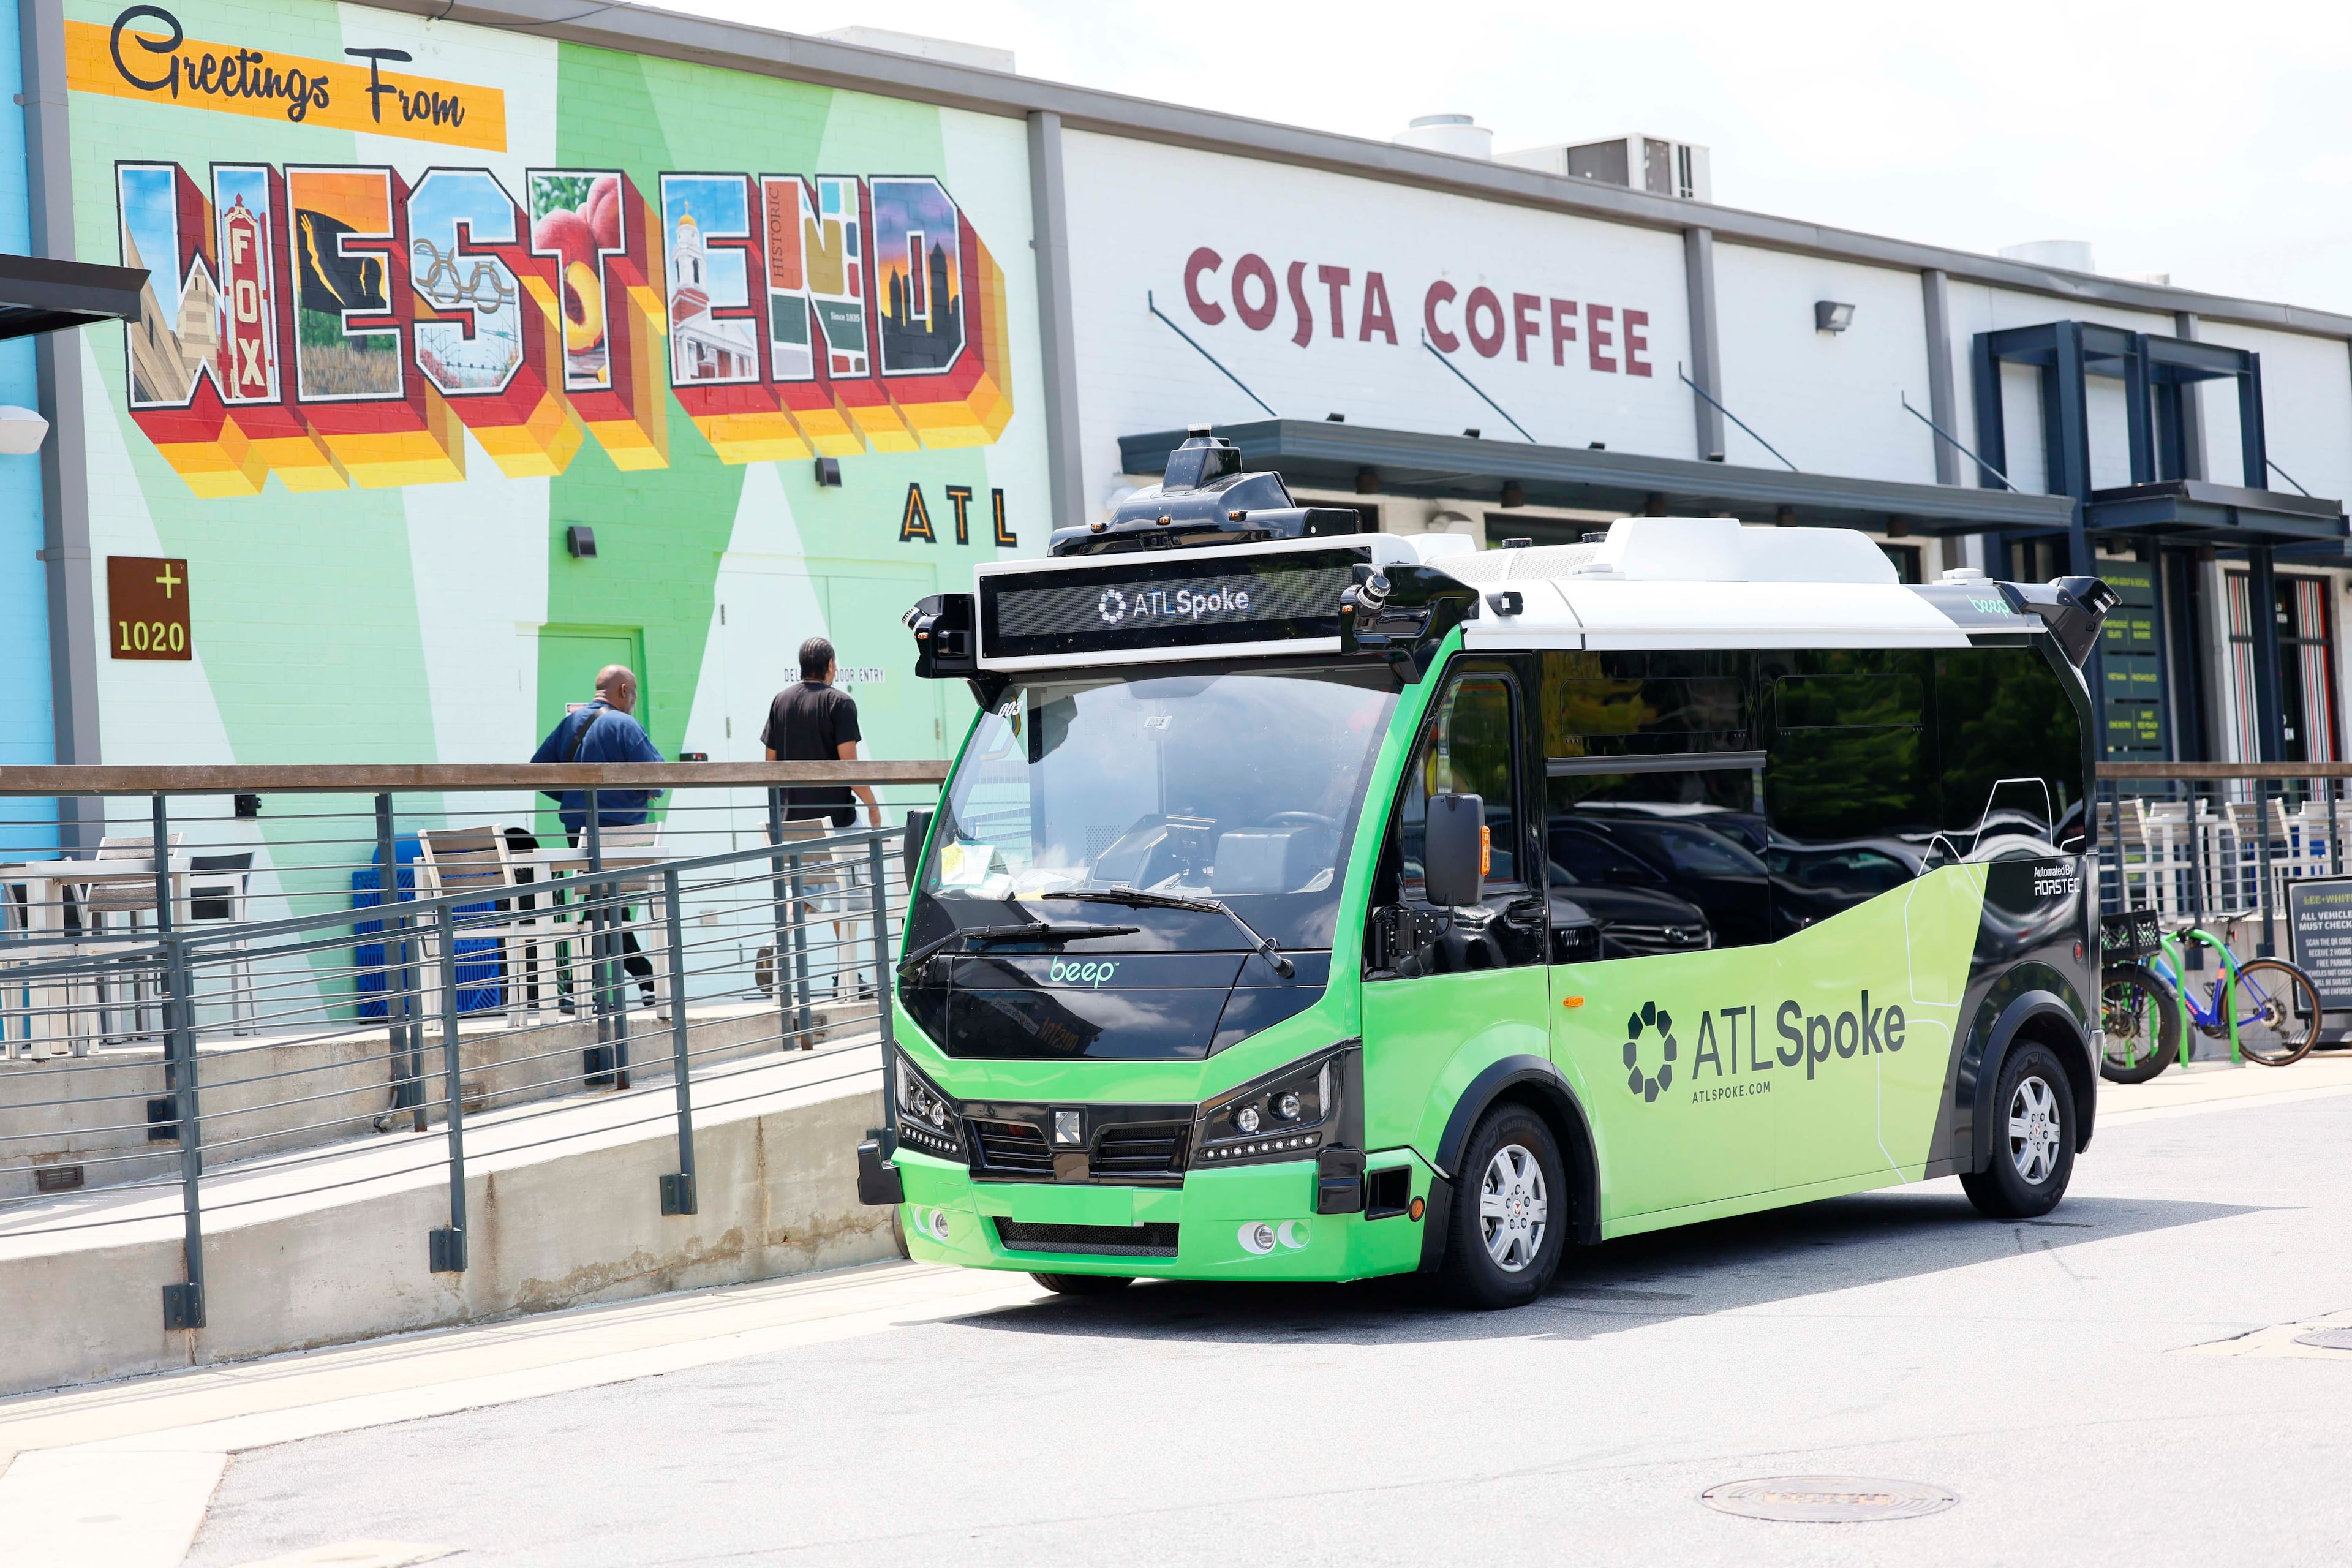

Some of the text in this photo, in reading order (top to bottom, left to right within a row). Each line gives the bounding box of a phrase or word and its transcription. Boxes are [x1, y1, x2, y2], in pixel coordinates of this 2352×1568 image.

[110, 5, 465, 127] Greetings From
[769, 187, 785, 277] HISTORIC
[115, 160, 967, 413] WEST END
[230, 227, 265, 386] FOX
[830, 311, 861, 322] Since 1835
[1184, 246, 1653, 377] COSTA COFFEE
[899, 483, 1018, 548] ATL
[1133, 586, 1250, 619] ATLSpoke
[1966, 594, 2010, 619] beep
[119, 620, 185, 652] 1020
[835, 668, 884, 682] DOOR ENTRY
[997, 700, 1023, 718] 003
[2034, 864, 2073, 878] Automated By
[2034, 877, 2081, 896] ADASTEC
[2304, 894, 2352, 905] LEE+WHIT
[2299, 921, 2323, 931] MUST
[2301, 912, 2316, 921] ALL
[2305, 938, 2320, 947] SCAN
[2320, 938, 2330, 946] THE
[2331, 937, 2338, 946] QR
[2309, 947, 2352, 957] RECEIVE 2 HOURS
[2316, 959, 2329, 968] FREE
[1692, 989, 1905, 1080] ATLSpoke
[1692, 1080, 1771, 1104] ATLSPOKE.COM
